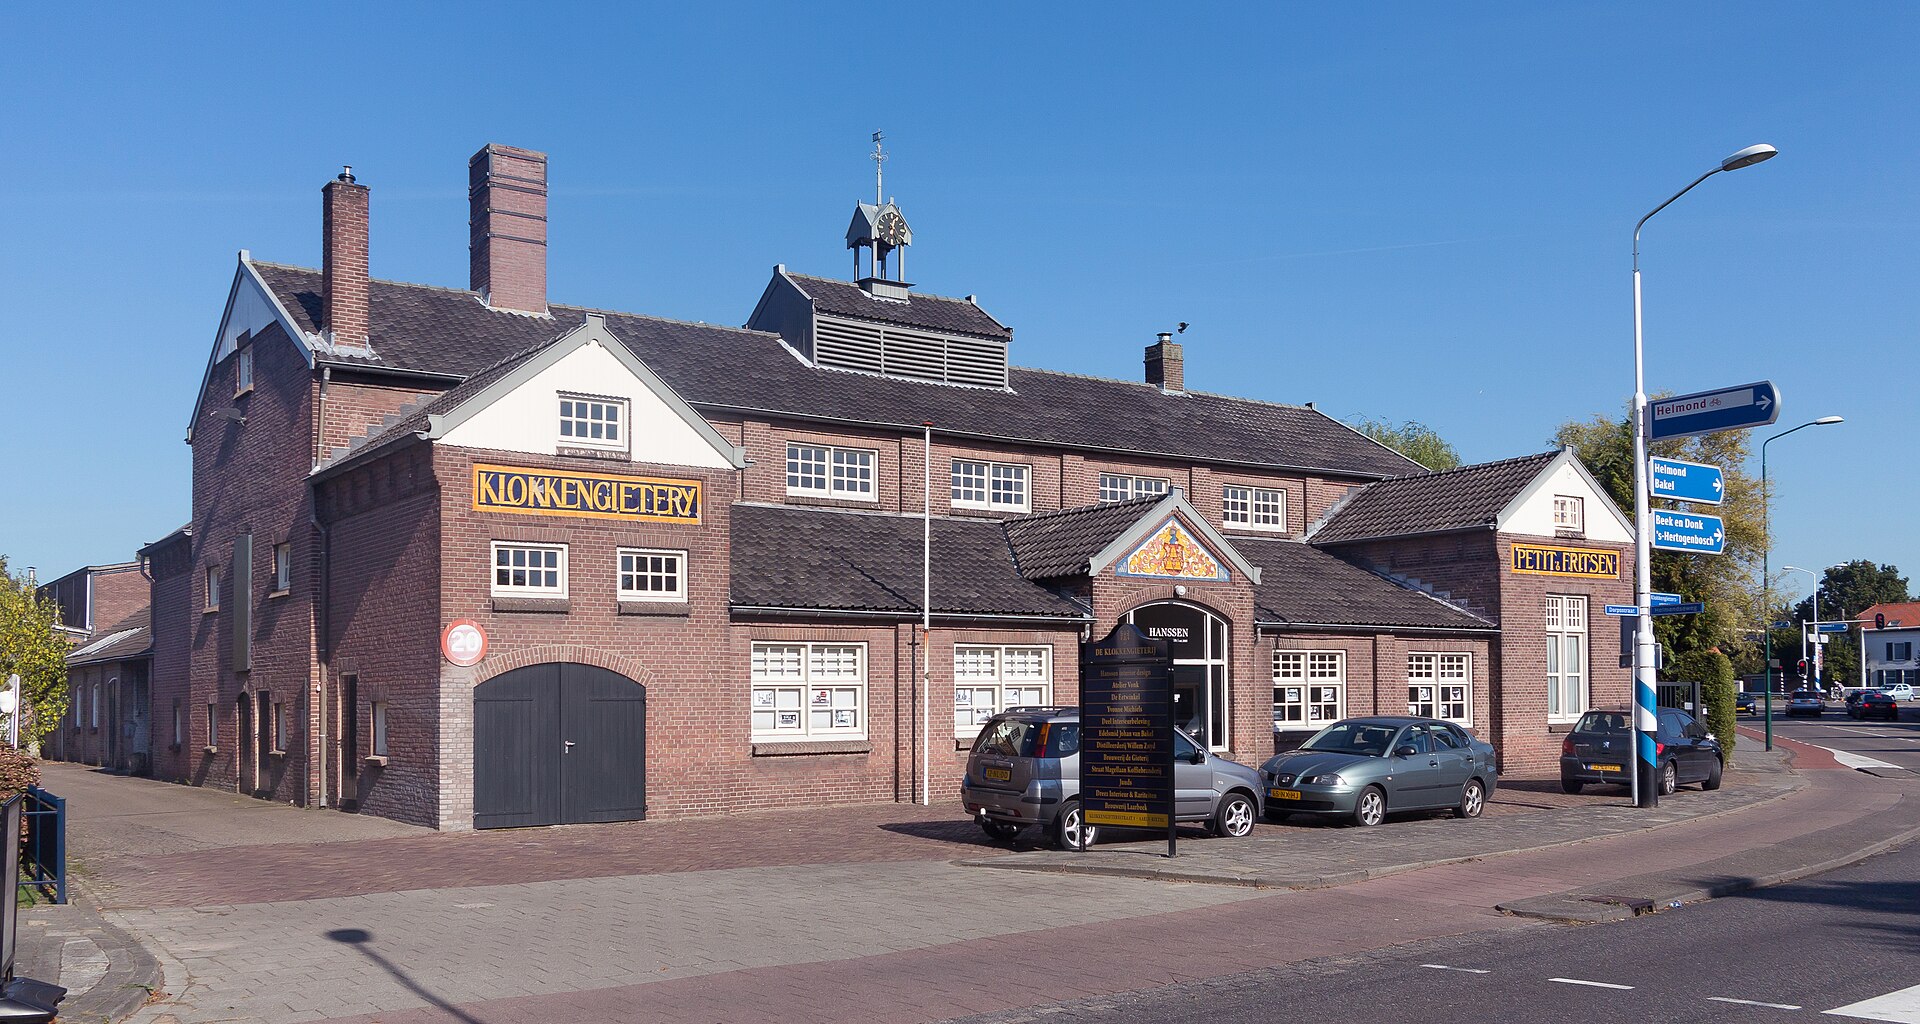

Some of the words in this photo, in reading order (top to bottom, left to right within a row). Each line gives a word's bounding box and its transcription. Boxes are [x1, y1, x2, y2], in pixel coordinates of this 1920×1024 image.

[1657, 399, 1706, 416] Helmond
[1655, 463, 1686, 477] Helmond
[1655, 478, 1674, 490] Bakel
[479, 472, 697, 516] KLOKKENGIETERY
[1656, 514, 1674, 526] Beek
[1685, 518, 1704, 530] Donk
[1656, 530, 1714, 546] 's-Hertogenbosch
[1518, 550, 1556, 570] PETIT
[1562, 552, 1613, 574] FRITSEN
[1149, 628, 1188, 637] HANSSEN
[452, 631, 478, 652] 20
[1104, 646, 1156, 656] KLOKKENGIETERIJ
[1104, 754, 1125, 762] Brouwerij
